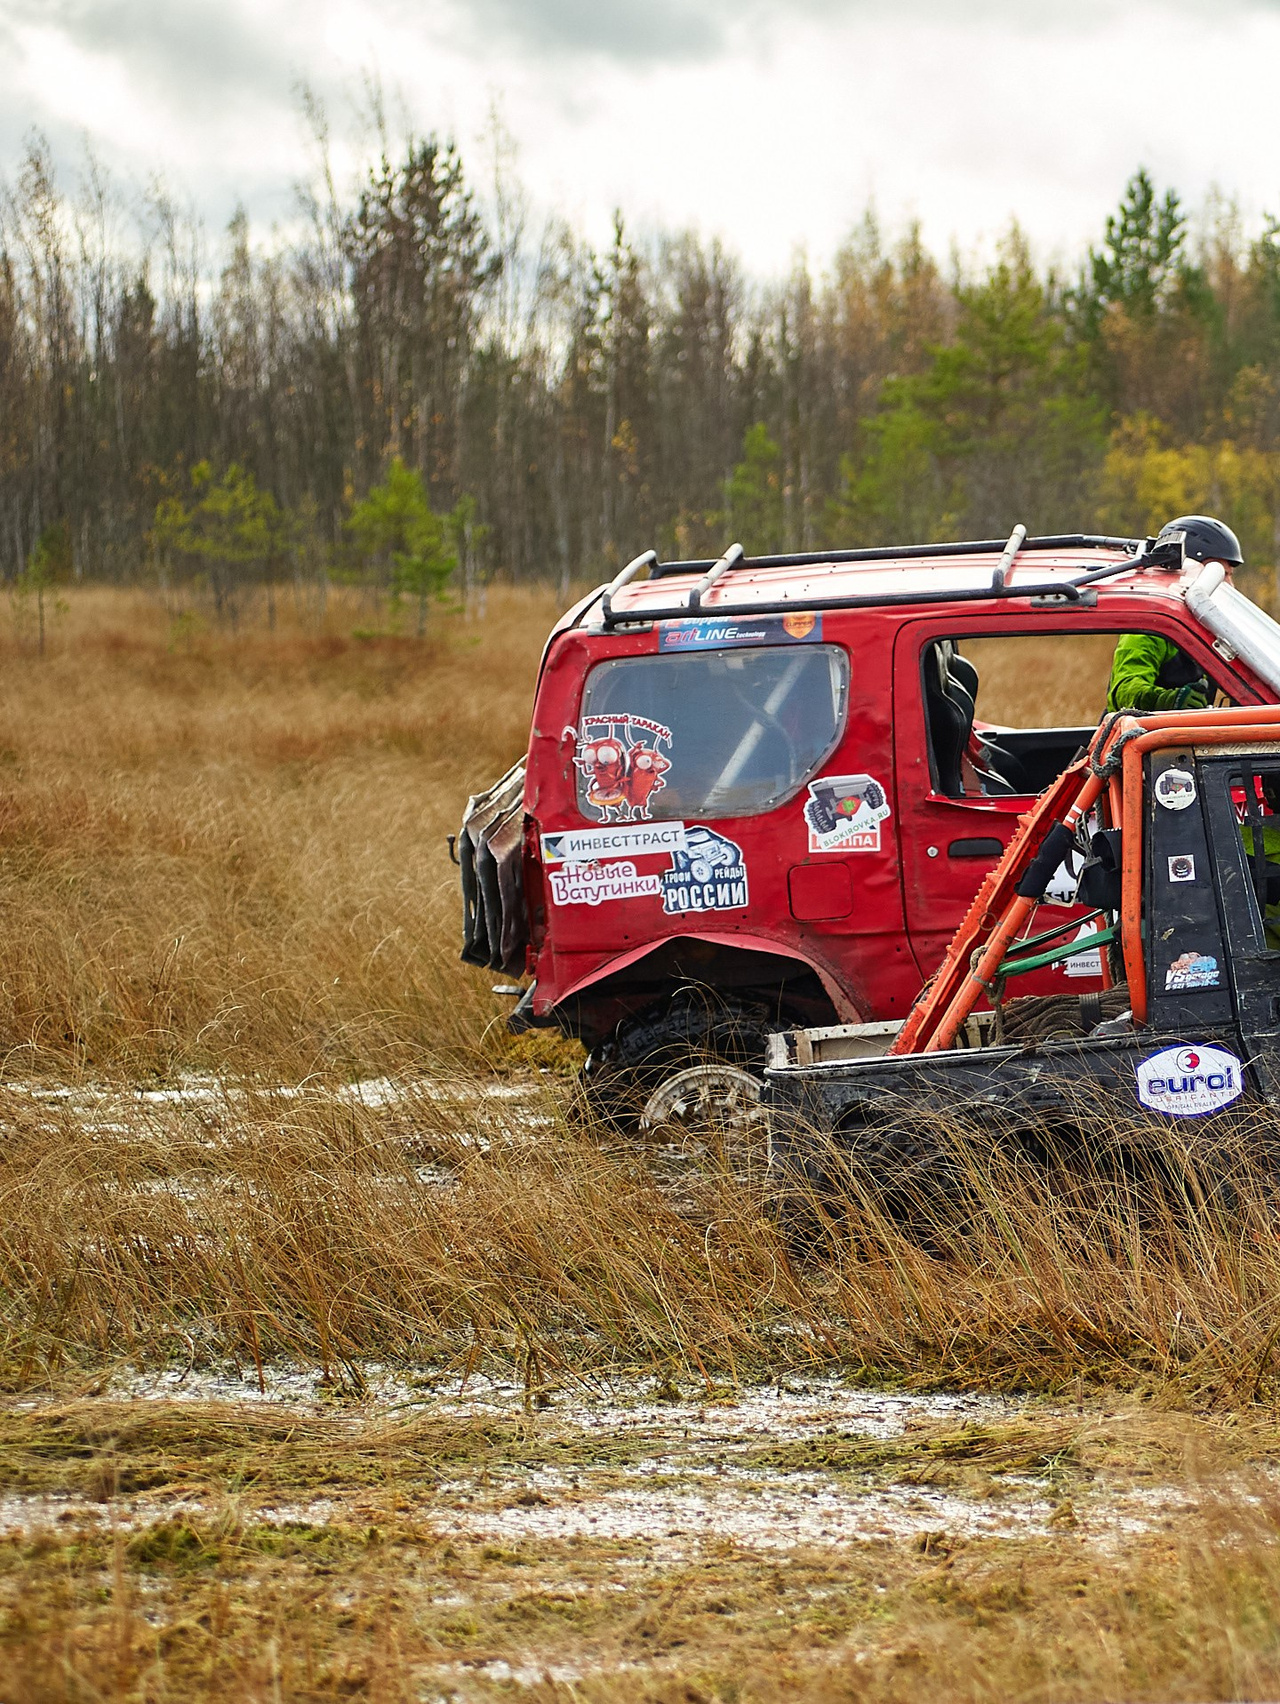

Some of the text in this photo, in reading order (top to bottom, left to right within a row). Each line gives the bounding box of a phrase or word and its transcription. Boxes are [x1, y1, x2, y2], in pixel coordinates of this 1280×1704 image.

[585, 714, 671, 739] КРАСНЫЙ ТАРАКАН
[569, 829, 680, 851] ИНВЕСТТРАСТ
[813, 809, 889, 847] BLOKIROVKA.RU
[560, 864, 633, 885] Новые
[664, 866, 743, 883] ТРОФИ РЕЙДЫ
[555, 877, 657, 901] Ватутинки
[667, 881, 745, 912] РОССИИ
[1147, 1066, 1234, 1095] eurol
[1147, 1091, 1235, 1104] LUBRICANTS
